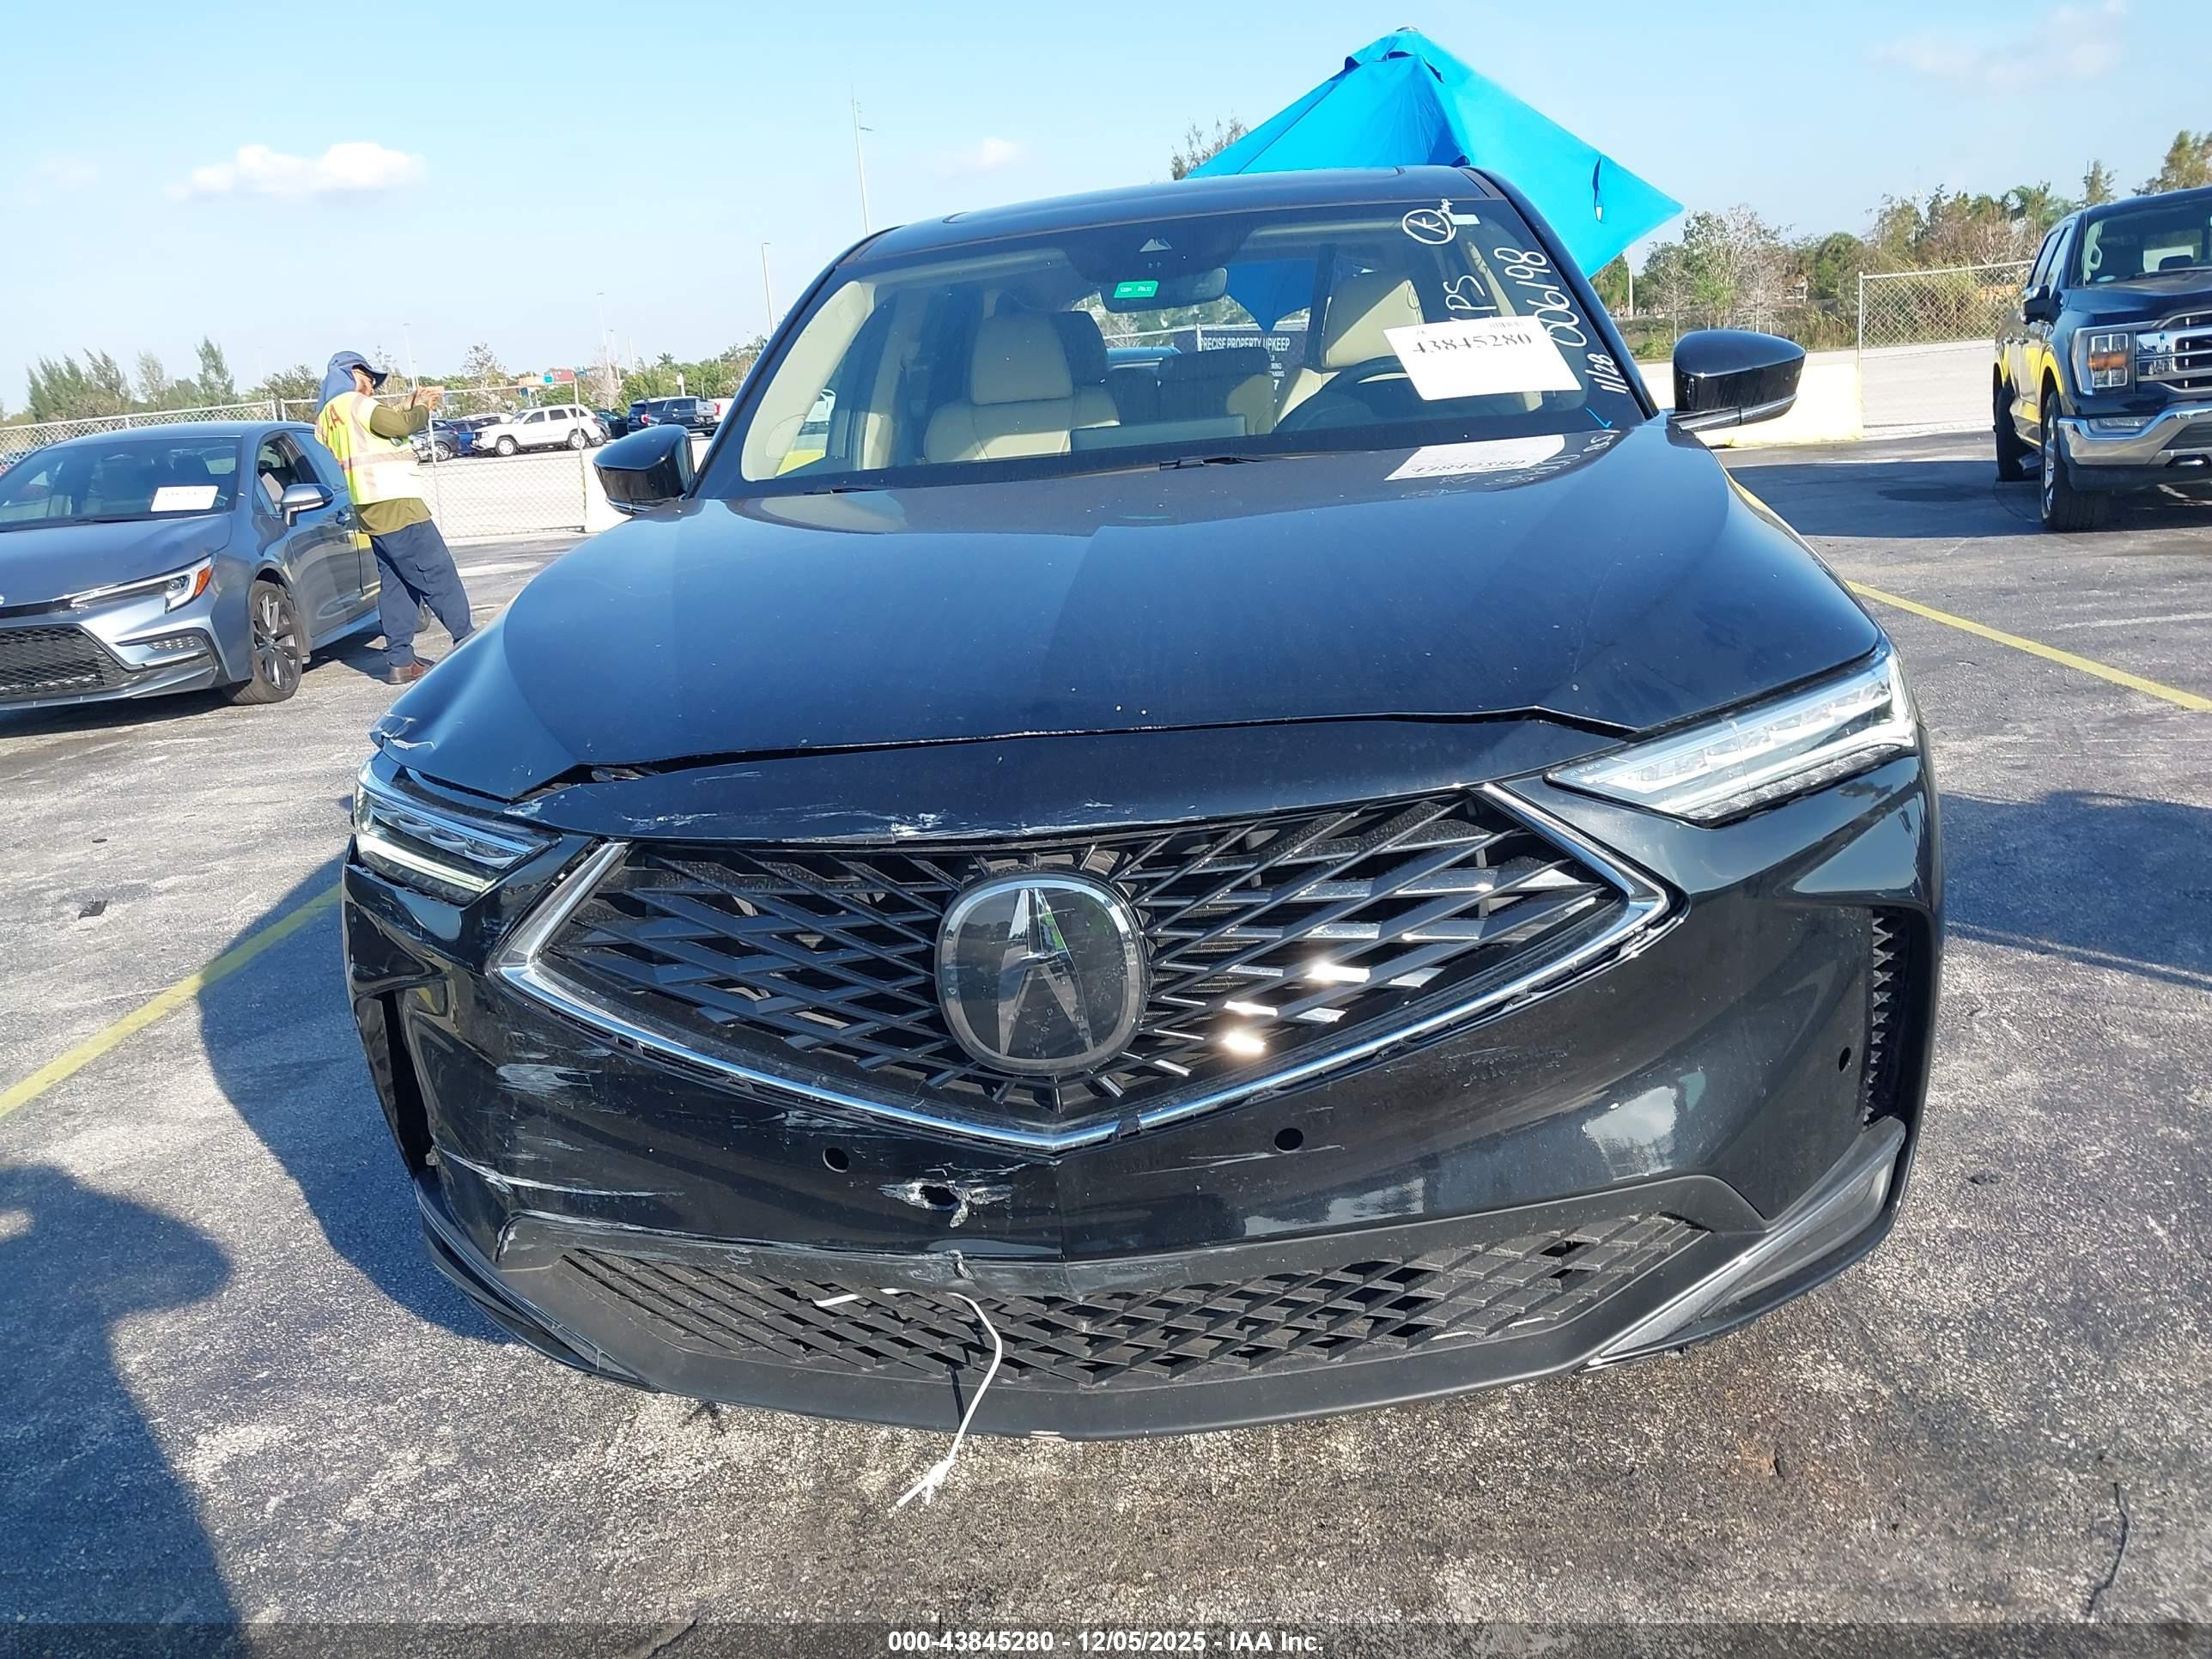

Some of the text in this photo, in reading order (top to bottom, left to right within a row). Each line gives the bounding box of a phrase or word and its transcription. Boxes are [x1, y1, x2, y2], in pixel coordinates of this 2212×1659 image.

[1493, 246, 1588, 348] 006198
[1413, 332, 1532, 354] 43845280
[1585, 353, 1630, 394] 11/28
